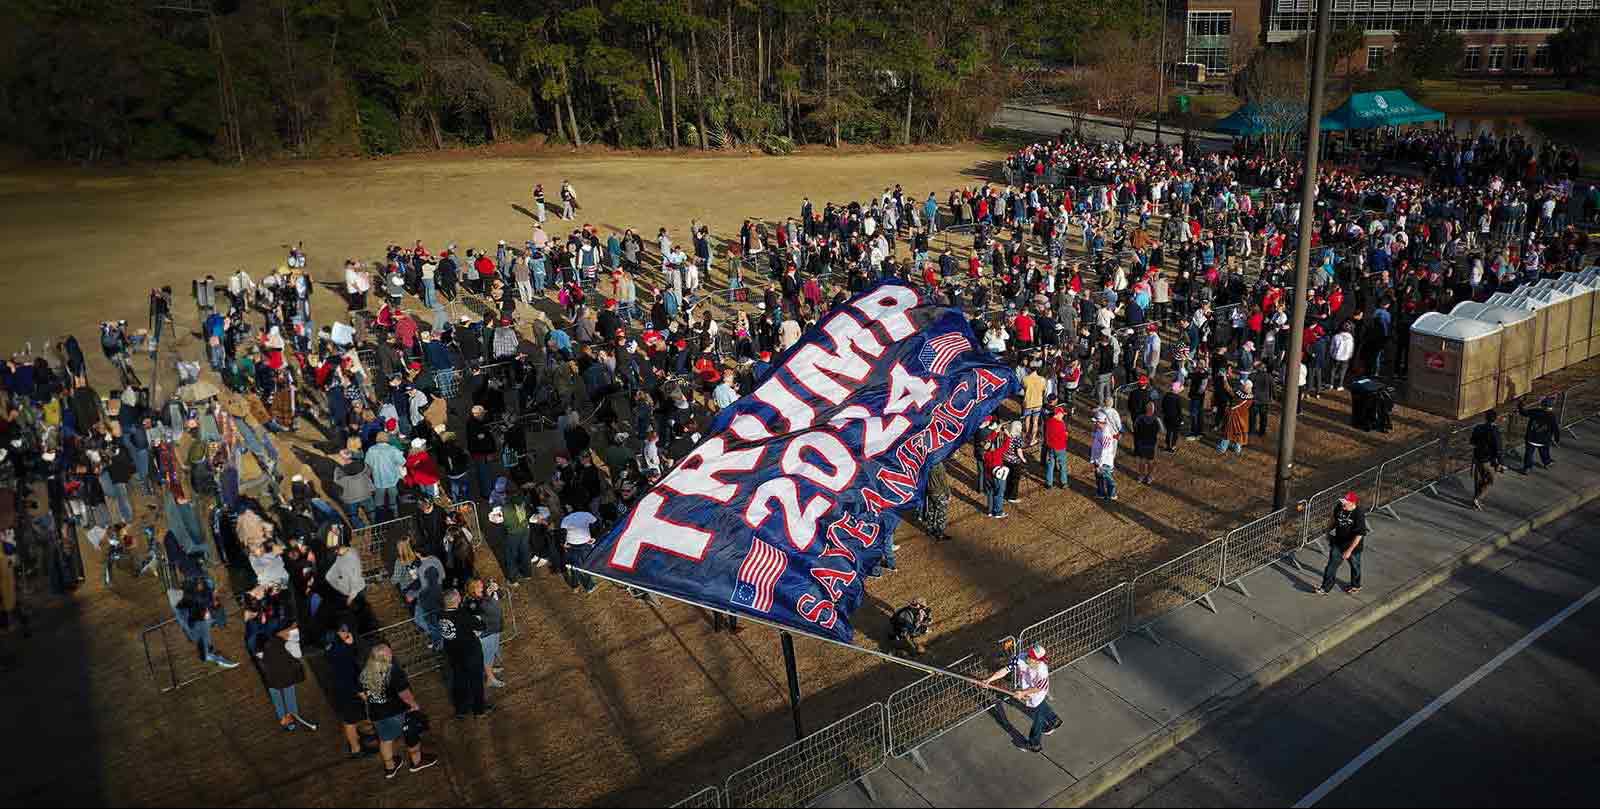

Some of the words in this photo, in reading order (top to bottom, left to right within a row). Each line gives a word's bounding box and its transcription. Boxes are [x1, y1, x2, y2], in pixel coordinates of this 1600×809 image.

[608, 284, 923, 570] TRUMP
[743, 362, 937, 550] 2024
[796, 511, 880, 630] SAVE
[860, 367, 1007, 516] AMERICA
